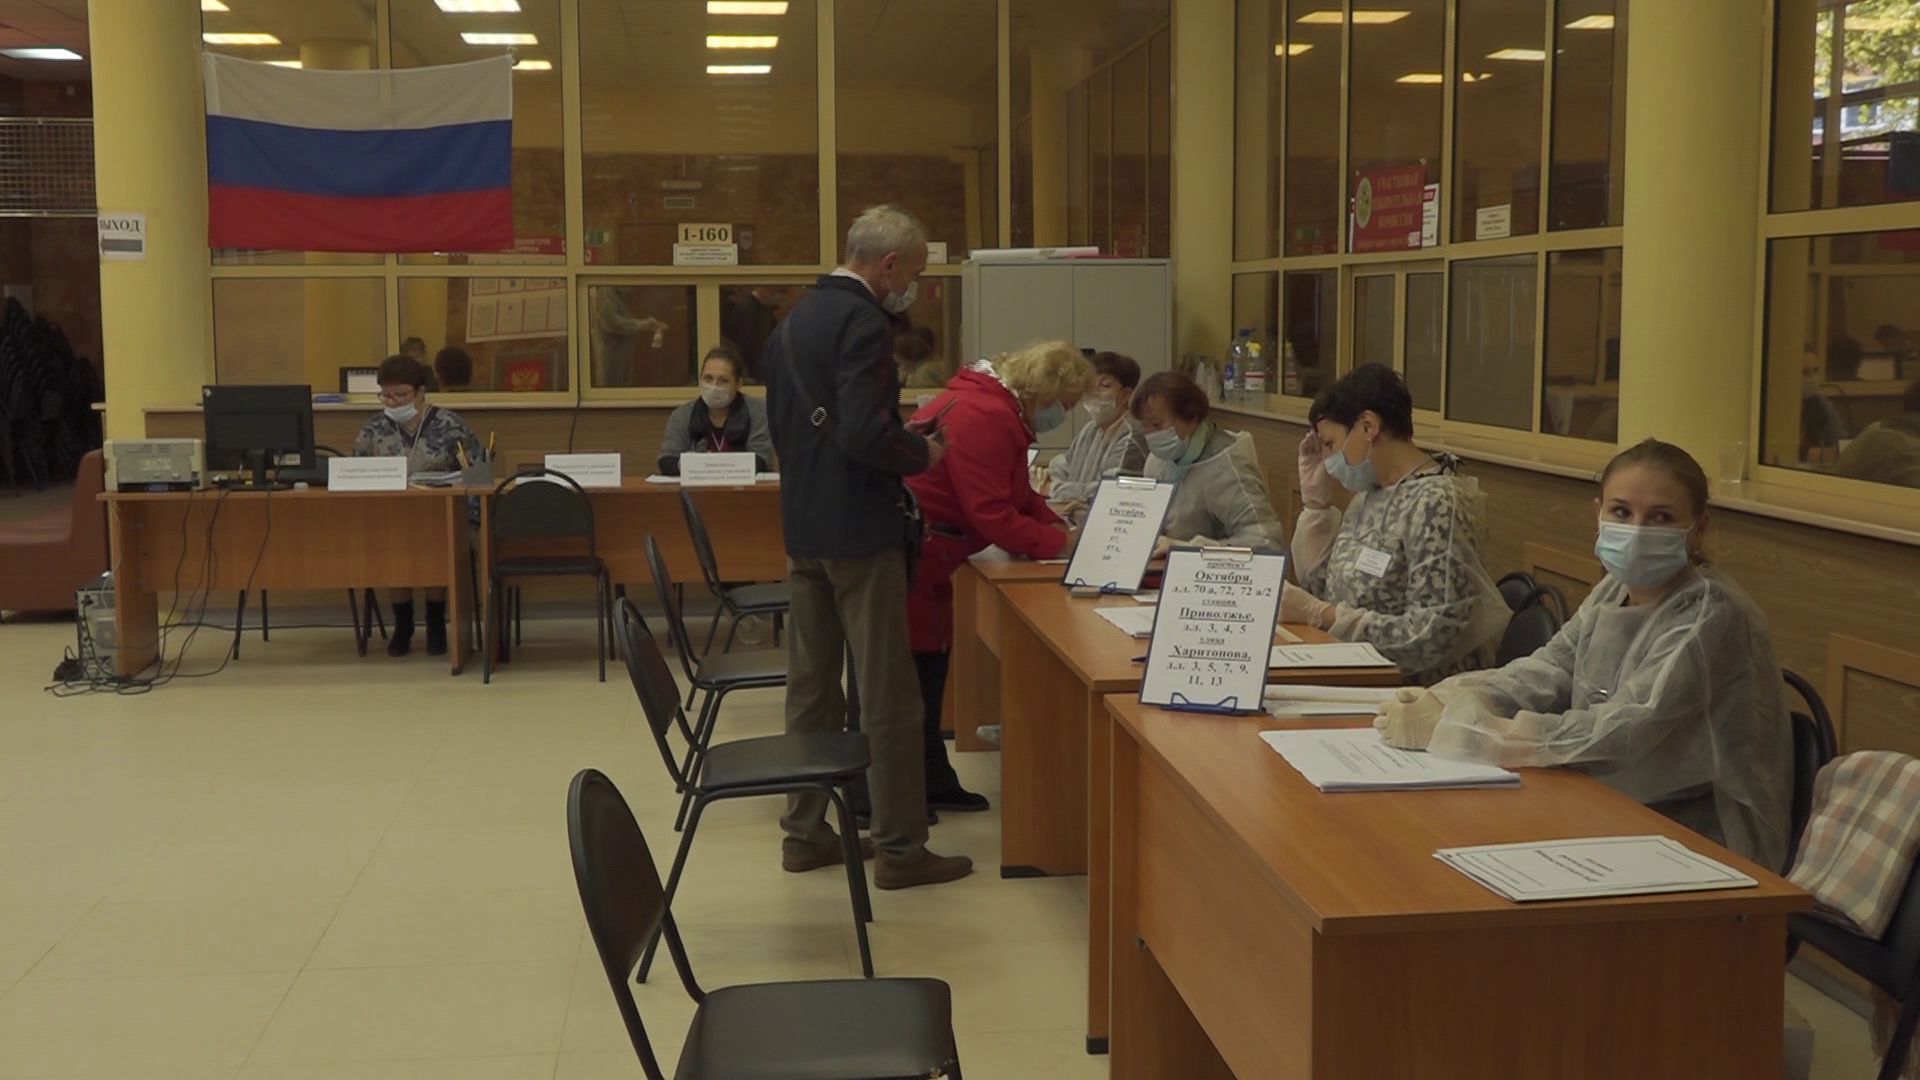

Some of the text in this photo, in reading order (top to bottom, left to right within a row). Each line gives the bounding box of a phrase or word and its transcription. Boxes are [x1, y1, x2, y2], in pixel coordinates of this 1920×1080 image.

[683, 227, 729, 241] 1-160
[1194, 571, 1253, 585] Октября,
[1220, 585, 1234, 596] 72,
[1178, 607, 1255, 622] Приволжье,
[1240, 625, 1247, 633] 5
[1170, 645, 1251, 661] Харитонова,
[1188, 675, 1222, 686] 11, 13
